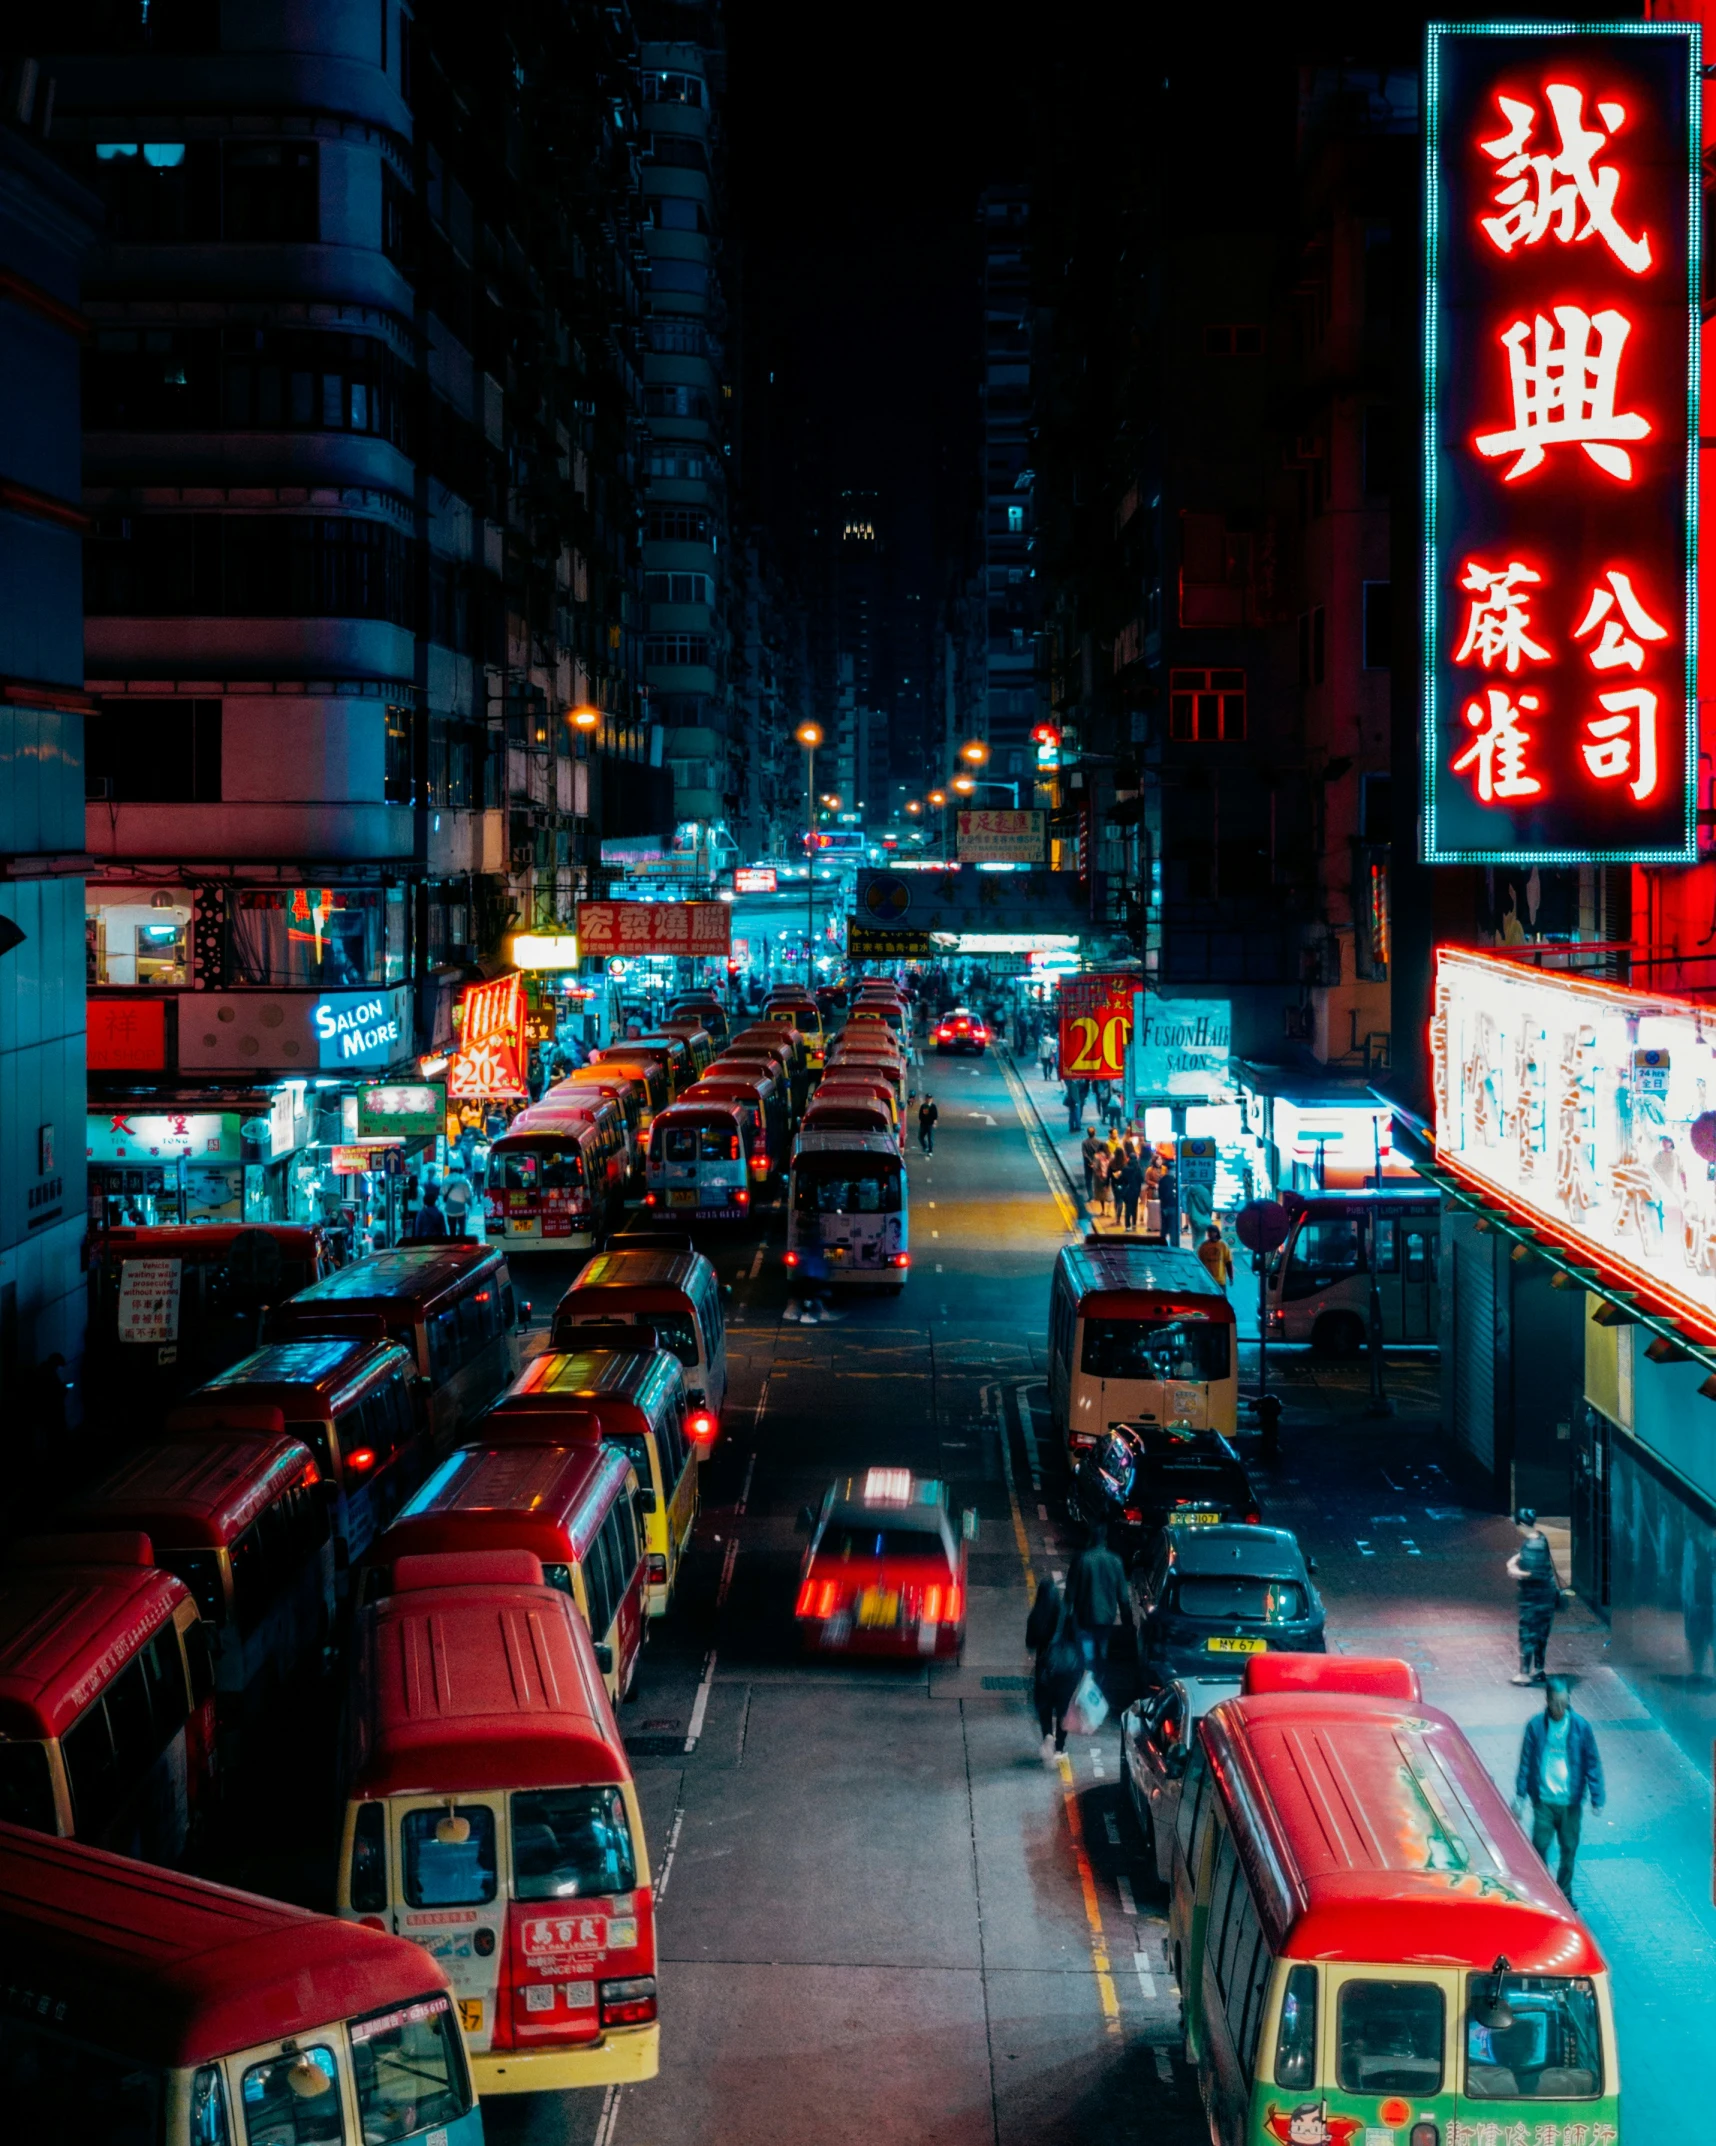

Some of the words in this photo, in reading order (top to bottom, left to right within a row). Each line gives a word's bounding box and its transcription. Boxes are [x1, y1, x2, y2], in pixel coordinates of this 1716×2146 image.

[1475, 83, 1654, 483] 誠興
[1573, 571, 1669, 801] 公司
[580, 905, 725, 940] 宏發燒臘
[105, 1009, 138, 1043] 祥
[316, 999, 383, 1039] SALON
[343, 1021, 398, 1058] MORE
[1069, 1017, 1132, 1070] 20
[114, 1049, 156, 1062] SHOP
[1166, 1054, 1207, 1070] SALON
[1642, 1078, 1662, 1088] 全日
[1652, 1069, 1665, 1077] hrs
[363, 1088, 443, 1115] 海天堂
[1188, 1168, 1208, 1178] 全日
[128, 1271, 155, 1280] waiting
[1239, 1642, 1255, 1651] 67
[532, 1919, 598, 1944] 馬百良
[569, 1941, 599, 1949] LEUNG
[409, 2007, 430, 2020] 6215
[429, 1999, 448, 2014] 6117
